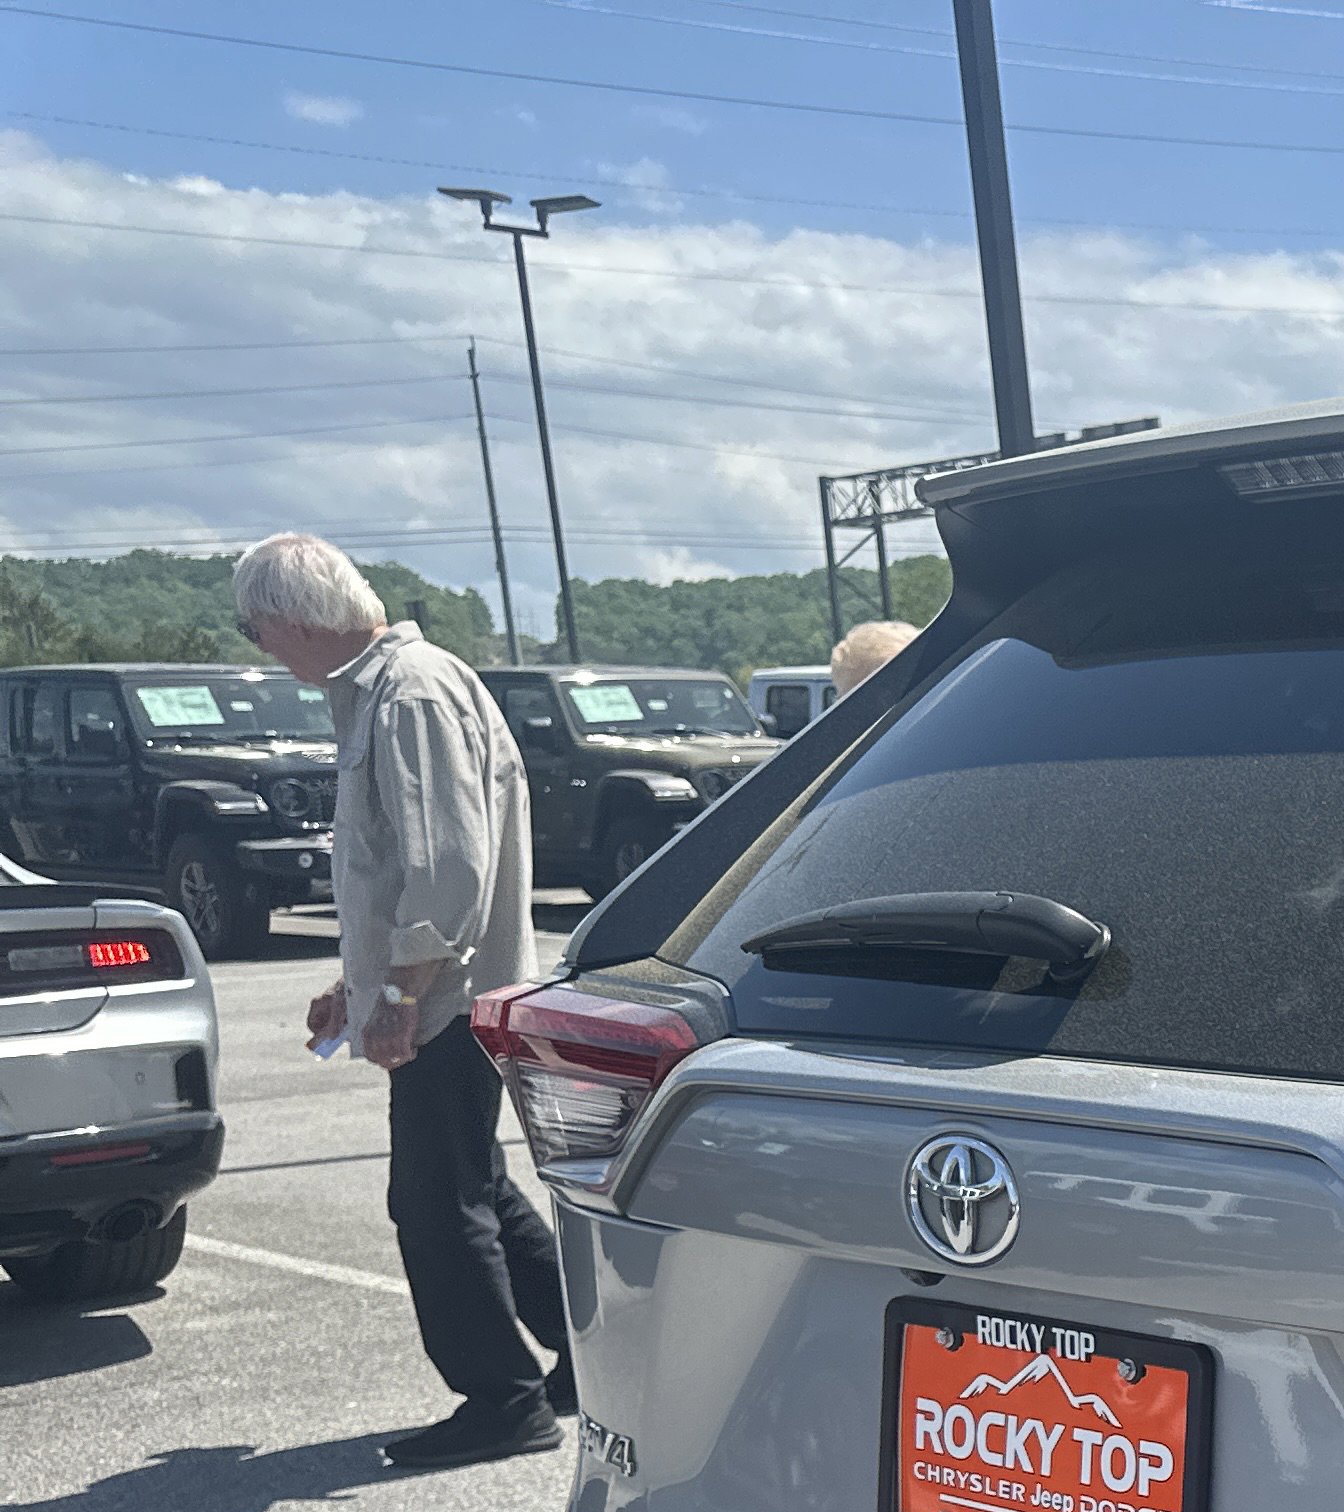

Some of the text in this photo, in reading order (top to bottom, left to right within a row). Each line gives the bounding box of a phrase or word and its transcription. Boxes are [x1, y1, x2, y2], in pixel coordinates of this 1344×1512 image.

[977, 1315, 1095, 1362] ROCKY TOP
[915, 1397, 1174, 1496] ROCKY TOP
[913, 1462, 1025, 1502] CHRYSLER
